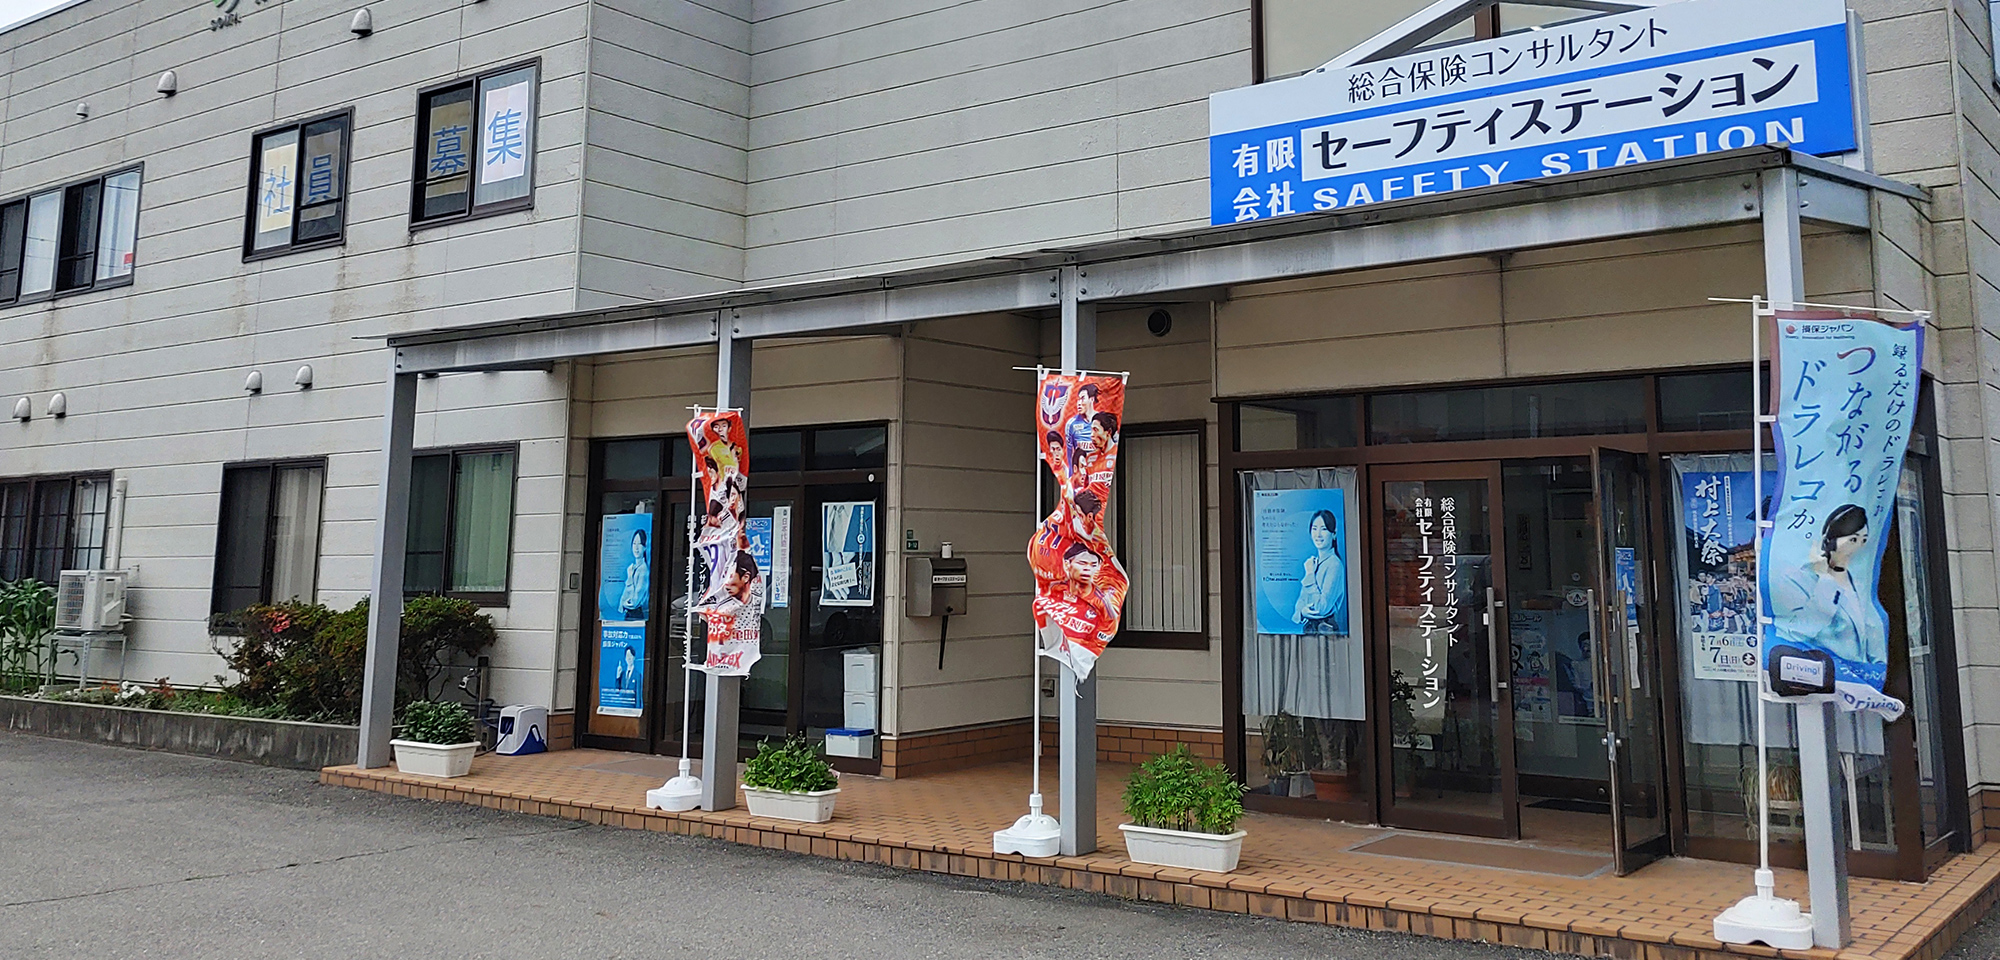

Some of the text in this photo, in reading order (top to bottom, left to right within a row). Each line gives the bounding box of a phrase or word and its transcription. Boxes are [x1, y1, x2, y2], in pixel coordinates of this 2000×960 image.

[1348, 18, 1668, 104] 総合保険コンサルタント
[1232, 136, 1295, 178] 有限
[1312, 57, 1799, 170] セーフティステーション
[1232, 181, 1296, 223] 会社
[1313, 117, 1805, 211] SAFETY STATION
[1801, 324, 1854, 334] 損保ジャパン
[1787, 360, 1828, 540] ドラレコか。
[1836, 346, 1877, 493] つながる
[1694, 475, 1727, 566] 村上大祭
[1416, 518, 1440, 709] セーフティステーション
[1440, 496, 1460, 647] 総合保険コンサルタント
